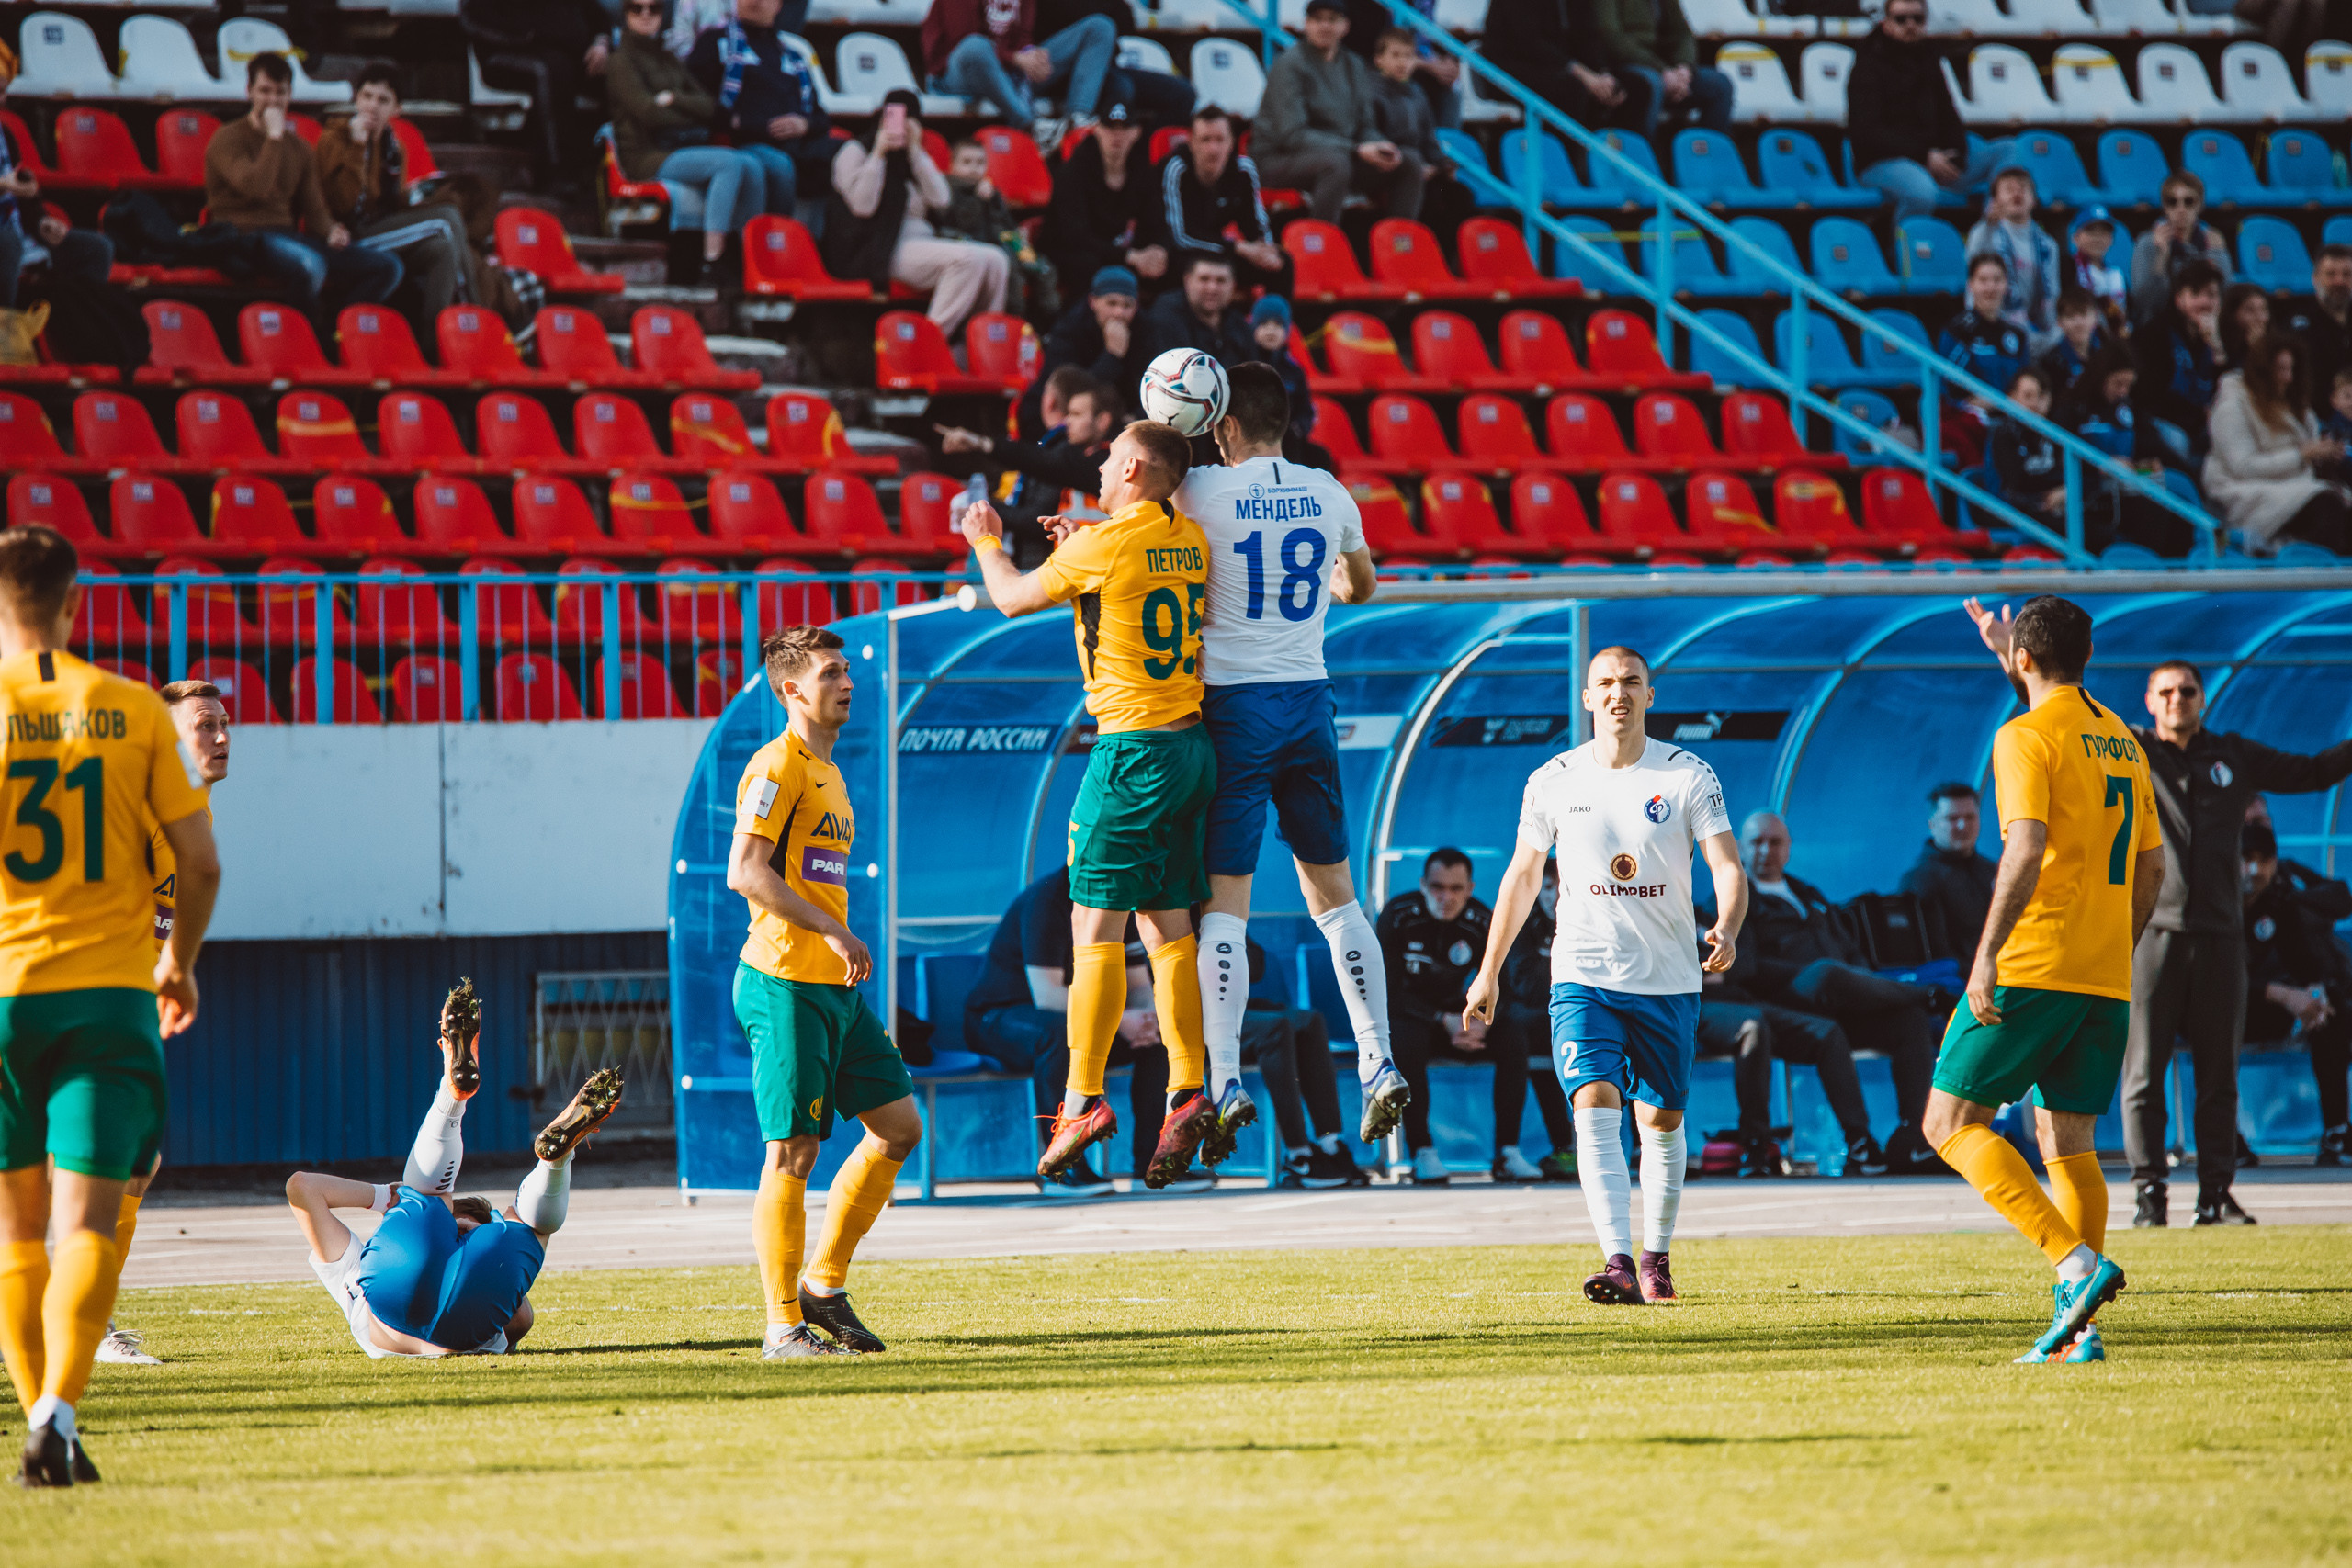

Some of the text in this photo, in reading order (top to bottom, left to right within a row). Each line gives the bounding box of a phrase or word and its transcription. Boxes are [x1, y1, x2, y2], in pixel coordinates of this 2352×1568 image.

[1236, 496, 1322, 522] МЕНДЕЛЬ
[1146, 547, 1204, 572] ПЕТРОВ
[1234, 527, 1327, 622] 18
[899, 727, 967, 751] ПОЧТА
[965, 727, 1051, 751] РОССИИ
[2081, 734, 2139, 763] ГУРФОВ
[4, 756, 104, 884] 31
[2104, 774, 2134, 885] 7
[812, 858, 845, 876] PARI
[1561, 1041, 1580, 1079] 2
